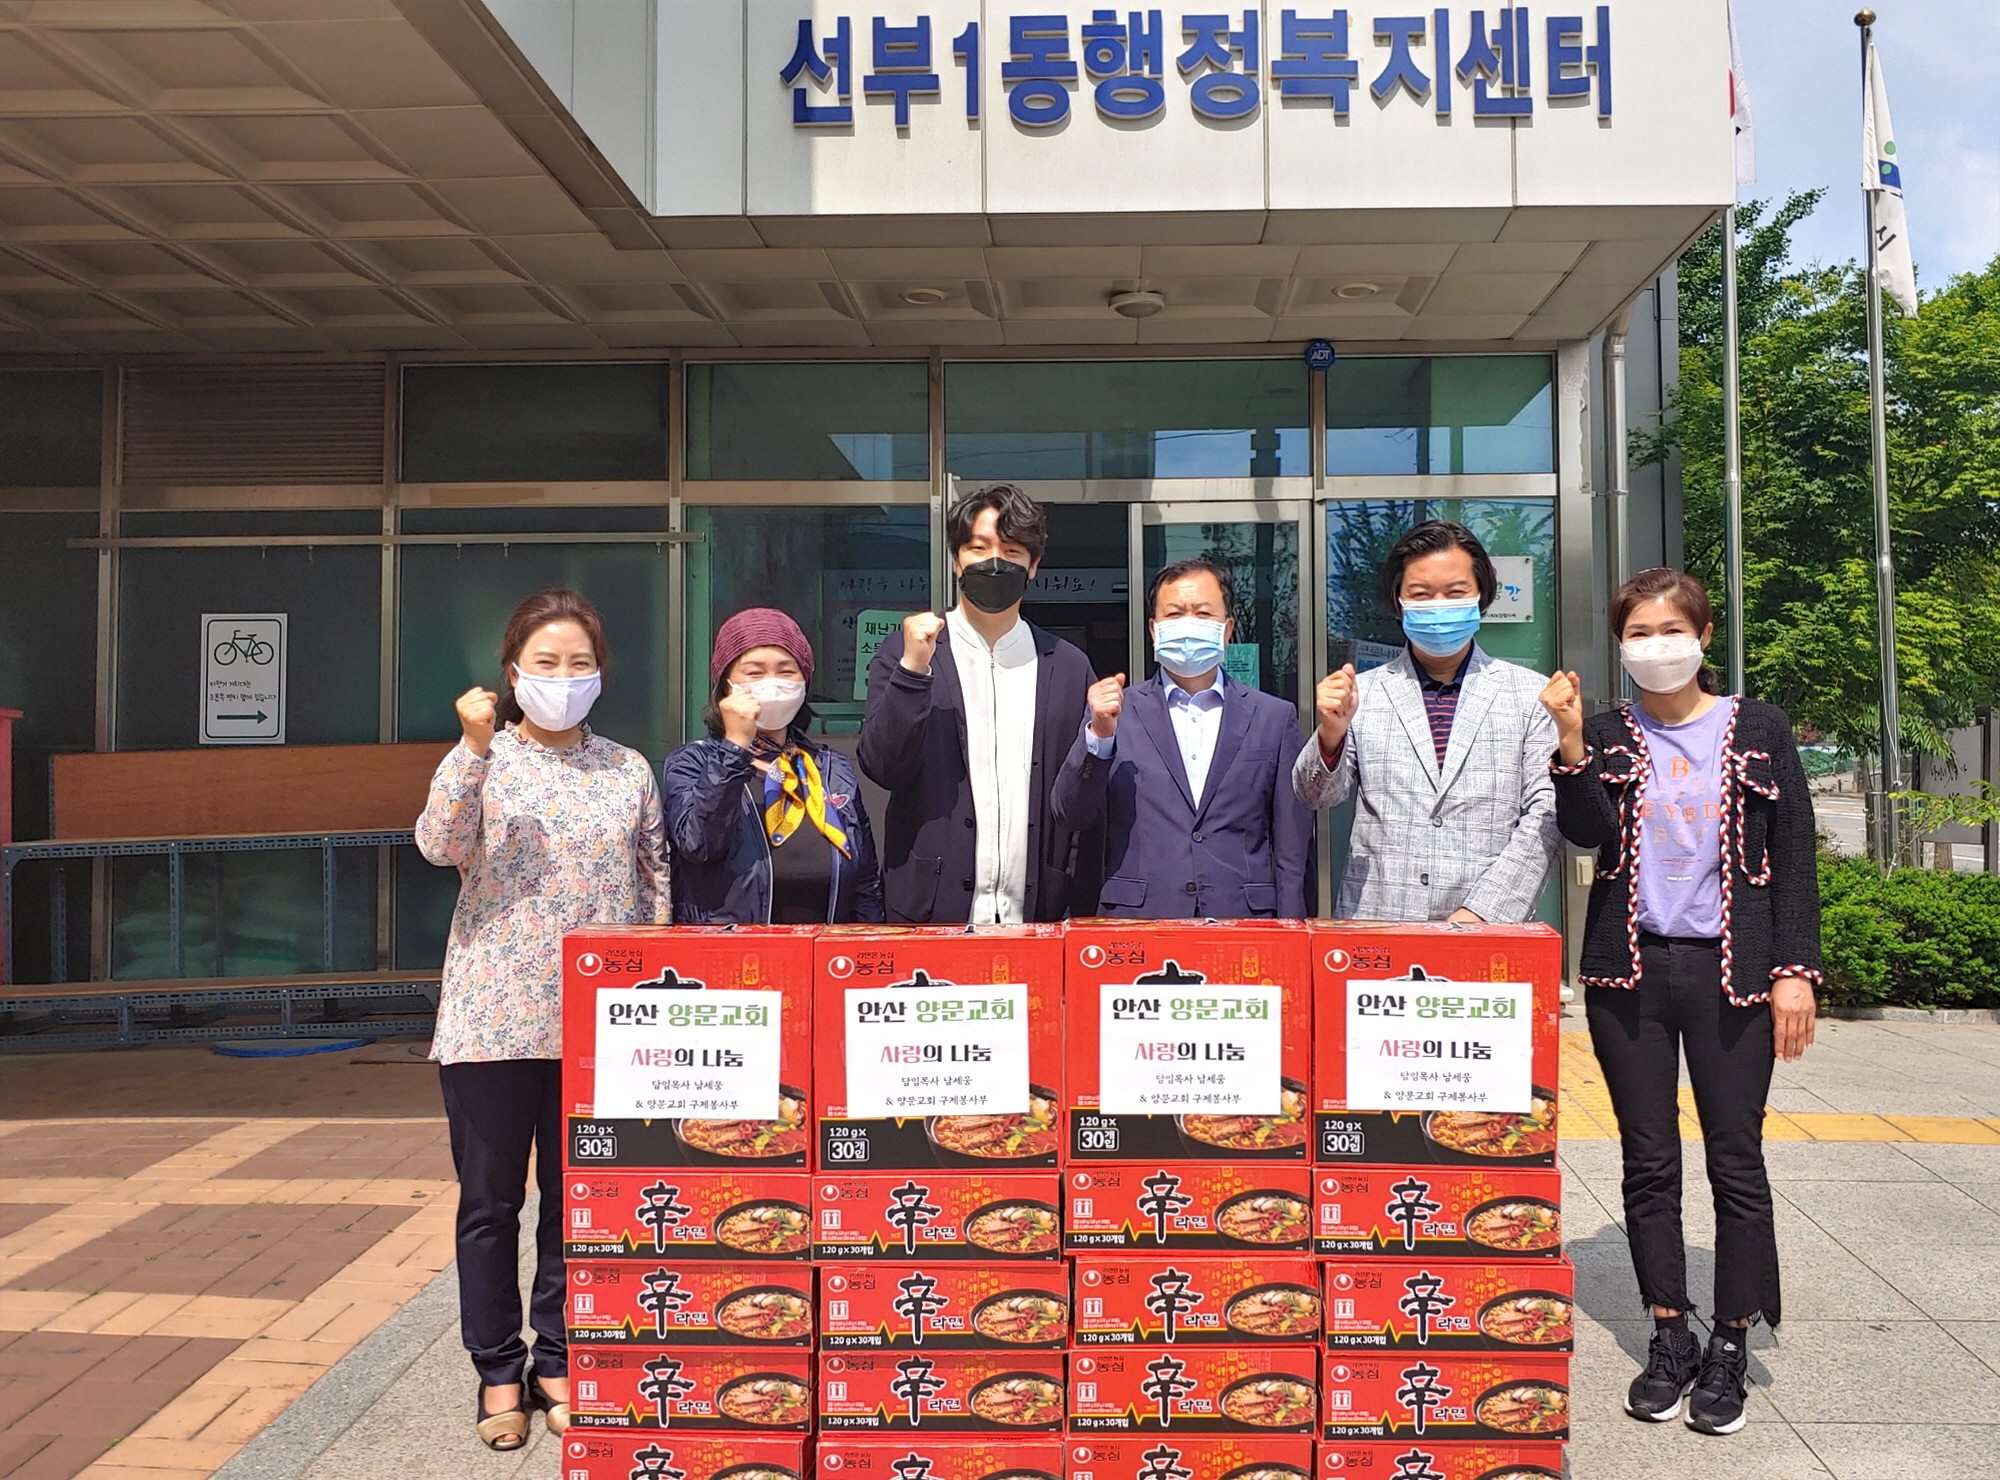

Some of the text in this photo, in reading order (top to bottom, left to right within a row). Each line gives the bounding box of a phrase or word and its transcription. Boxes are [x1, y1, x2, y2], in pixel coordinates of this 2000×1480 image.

[778, 5, 1613, 131] 선부1동행정복지센터
[1311, 349, 1331, 360] ADT
[1035, 575, 1096, 593] 나눠요!
[1670, 758, 1690, 778] B
[1642, 801, 1721, 823] EYED
[1108, 951, 1145, 965] 농심
[1352, 955, 1391, 969] 농심
[605, 958, 643, 973] 농심
[856, 961, 894, 975] 농심
[858, 999, 1014, 1023] 안산 양문교회
[1113, 998, 1268, 1020] 안산 양문교회
[1357, 994, 1515, 1019] 안산 양문교회
[609, 1004, 767, 1026] 안산 양문교회
[881, 1044, 991, 1063] 사랑의 나눔
[1135, 1042, 1245, 1061] 사랑의 나눔
[1380, 1040, 1492, 1060] 사랑의 나눔
[632, 1048, 743, 1067] 사랑의 나눔
[902, 1076, 972, 1086] 담임목사 남세웅
[1156, 1074, 1225, 1084] 담임목사 남세웅
[1401, 1072, 1471, 1083] 담임목사 남세웅
[652, 1080, 721, 1090] 담임목사 남세웅
[897, 1096, 935, 1106] 양문교회
[940, 1095, 987, 1105] 구제봉사부
[1151, 1094, 1188, 1103] 양문교회
[1193, 1094, 1240, 1103] 구제봉사부
[1384, 1091, 1487, 1102] & 양문교회 구제봉사부
[647, 1100, 685, 1109] 양문교회
[690, 1100, 738, 1110] 구제봉사부
[1093, 1177, 1120, 1188] 농심
[1341, 1183, 1369, 1193] 농심
[591, 1186, 619, 1198] 농심
[841, 1189, 868, 1199] 농심
[1138, 1170, 1192, 1243] 辛
[637, 1181, 691, 1252] 辛
[887, 1181, 940, 1254] 辛
[1387, 1177, 1440, 1250] 辛
[1175, 1216, 1207, 1228] 라면
[675, 1226, 707, 1239] 라면
[924, 1228, 956, 1240] 라면
[1424, 1224, 1455, 1236] 라면
[593, 1273, 620, 1284] 농심
[849, 1279, 876, 1290] 농심
[1102, 1273, 1130, 1285] 농심
[1354, 1277, 1382, 1288] 농심
[639, 1268, 692, 1338] 辛
[895, 1272, 947, 1344] 辛
[1147, 1267, 1202, 1343] 辛
[1400, 1271, 1455, 1344] 辛
[676, 1313, 707, 1325] 라면
[931, 1317, 964, 1329] 라면
[1185, 1314, 1218, 1327] 라면
[1437, 1318, 1469, 1330] 라면
[596, 1358, 623, 1369] 농심
[847, 1360, 874, 1371] 농심
[1097, 1362, 1124, 1373] 농심
[1351, 1369, 1379, 1379] 농심
[640, 1355, 695, 1427] 辛
[892, 1356, 946, 1425] 辛
[1142, 1355, 1196, 1426] 辛
[1397, 1362, 1451, 1434] 辛
[678, 1402, 711, 1414] 라면
[929, 1399, 961, 1411] 라면
[1179, 1400, 1211, 1412] 라면
[1434, 1408, 1466, 1420] 라면
[588, 1447, 614, 1458] 농심
[1093, 1450, 1120, 1461] 농심
[844, 1457, 871, 1468] 농심
[1345, 1456, 1373, 1466] 농심
